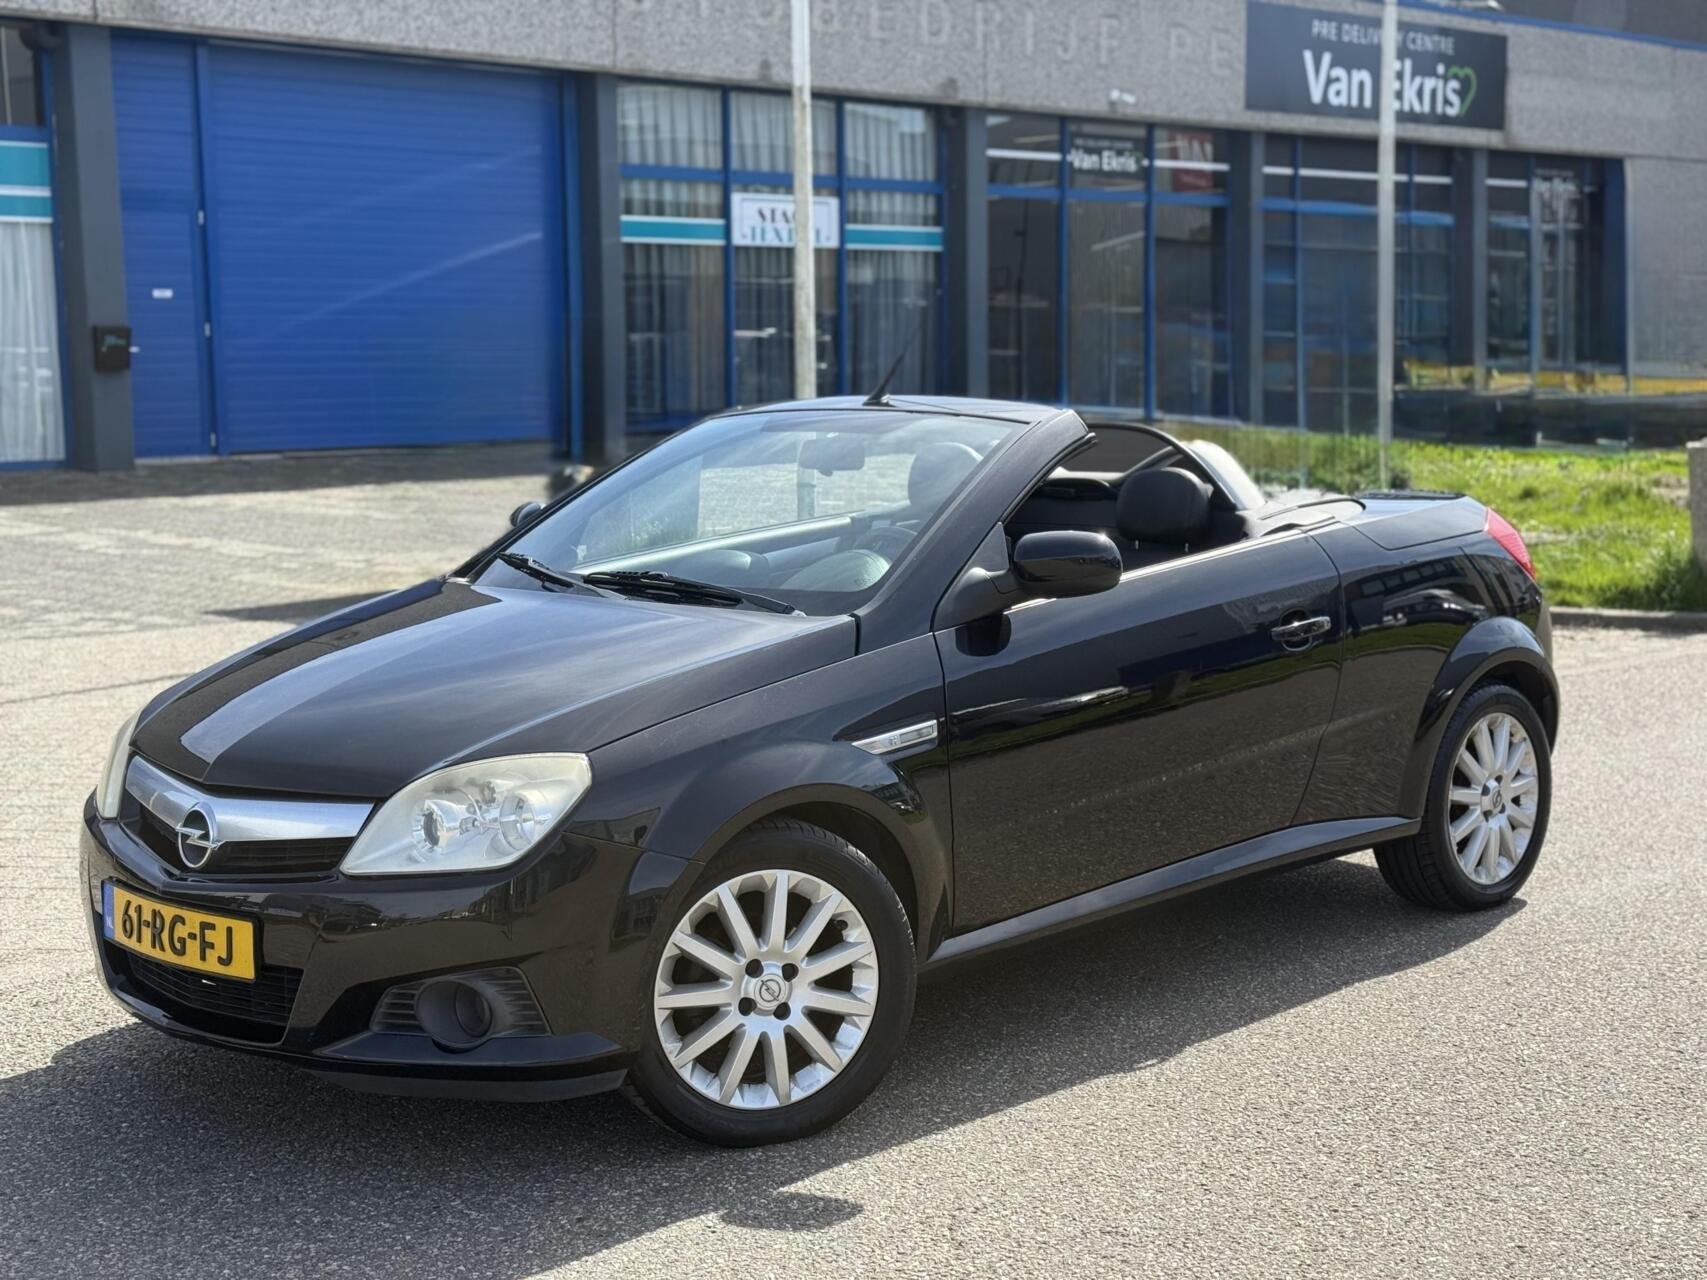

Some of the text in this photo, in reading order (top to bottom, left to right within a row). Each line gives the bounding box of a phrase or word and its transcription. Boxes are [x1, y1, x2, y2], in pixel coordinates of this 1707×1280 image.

[1311, 19, 1456, 56] PRE DELIVY CENTRE
[1302, 48, 1373, 109] Van
[121, 899, 234, 967] 61-RG-FJ
